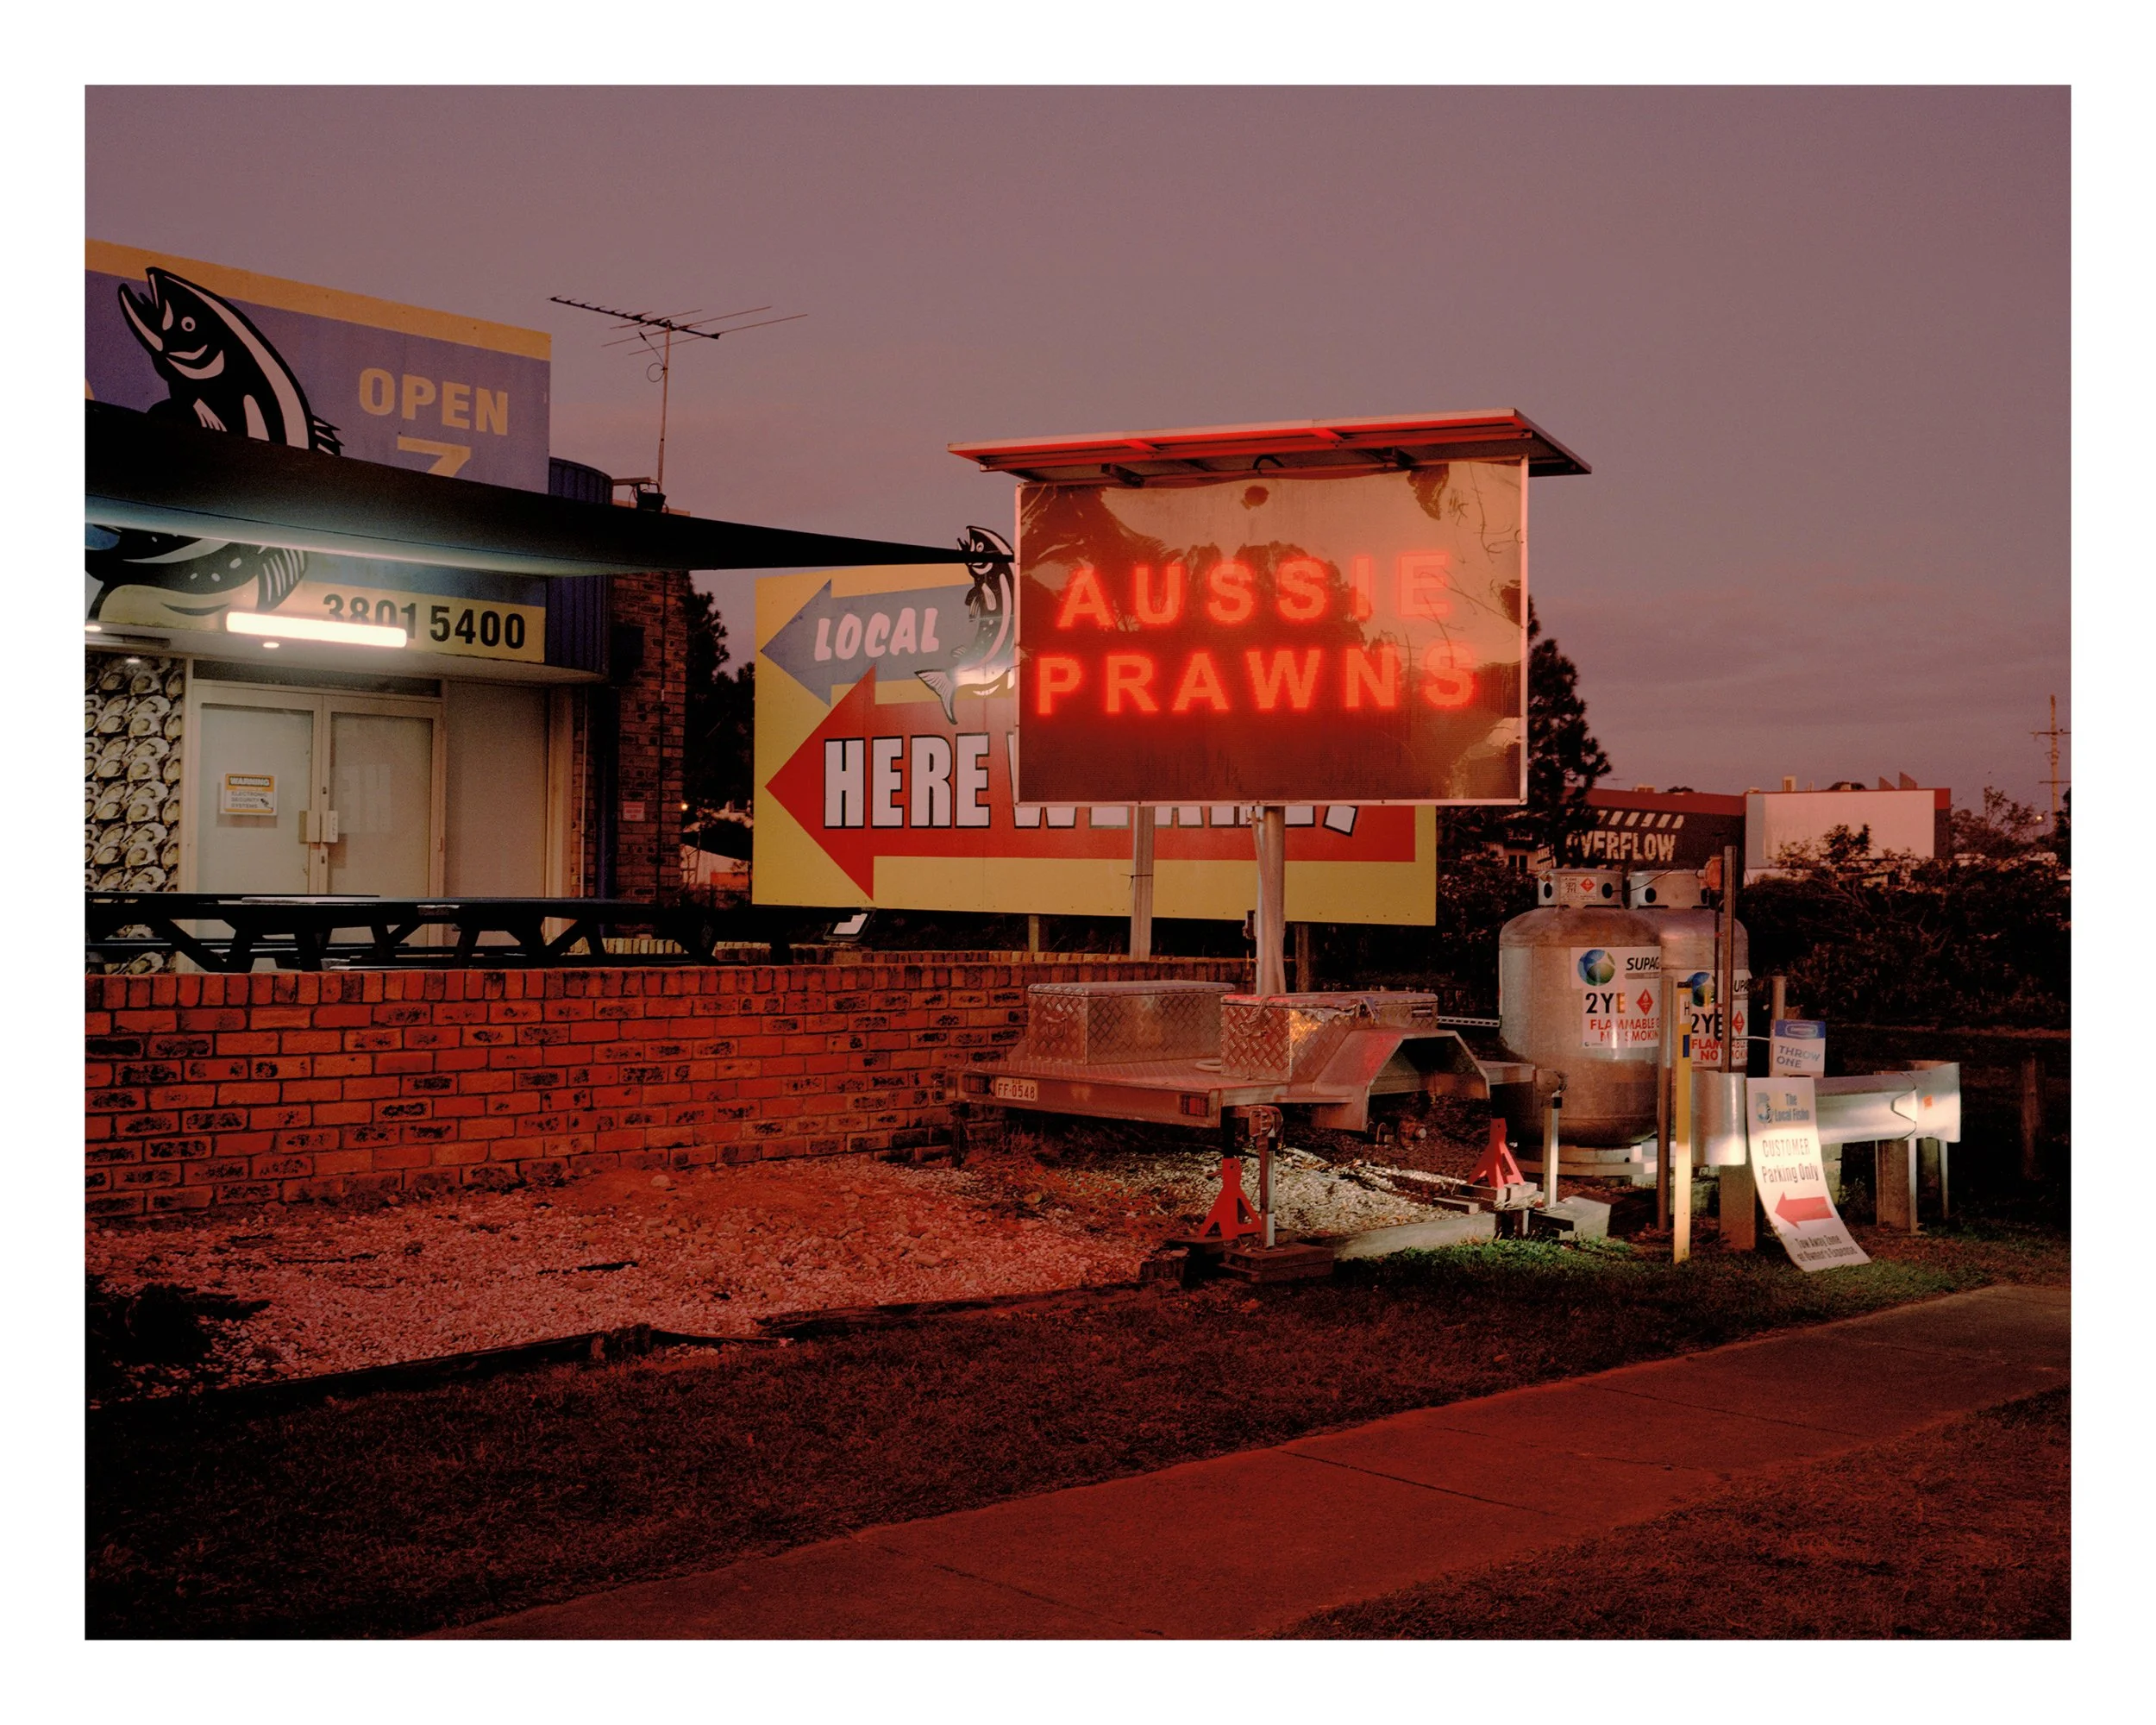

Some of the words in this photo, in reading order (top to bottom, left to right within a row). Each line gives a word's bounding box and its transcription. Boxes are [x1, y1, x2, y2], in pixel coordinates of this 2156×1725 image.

[359, 367, 509, 436] OPEN
[1056, 552, 1449, 629] AUSSIE
[429, 605, 525, 649] 5400
[813, 607, 940, 662] LOCAL
[1037, 643, 1477, 715] PRAWNS
[229, 776, 270, 787] WARNING
[824, 732, 991, 829] HERE
[1566, 830, 1676, 862] OVERFLOW
[1585, 993, 1626, 1014] 2YE
[1590, 1018, 1655, 1030] FLAMMABLE
[1700, 1051, 1719, 1061] NO
[1777, 1056, 1803, 1069] ONE
[1779, 1044, 1821, 1062] THROW
[1785, 1093, 1798, 1106] The
[1774, 1108, 1792, 1122] Local
[1762, 1138, 1811, 1157] CUSTOMER
[1761, 1164, 1798, 1183] Parking
[1799, 1164, 1820, 1182] Only
